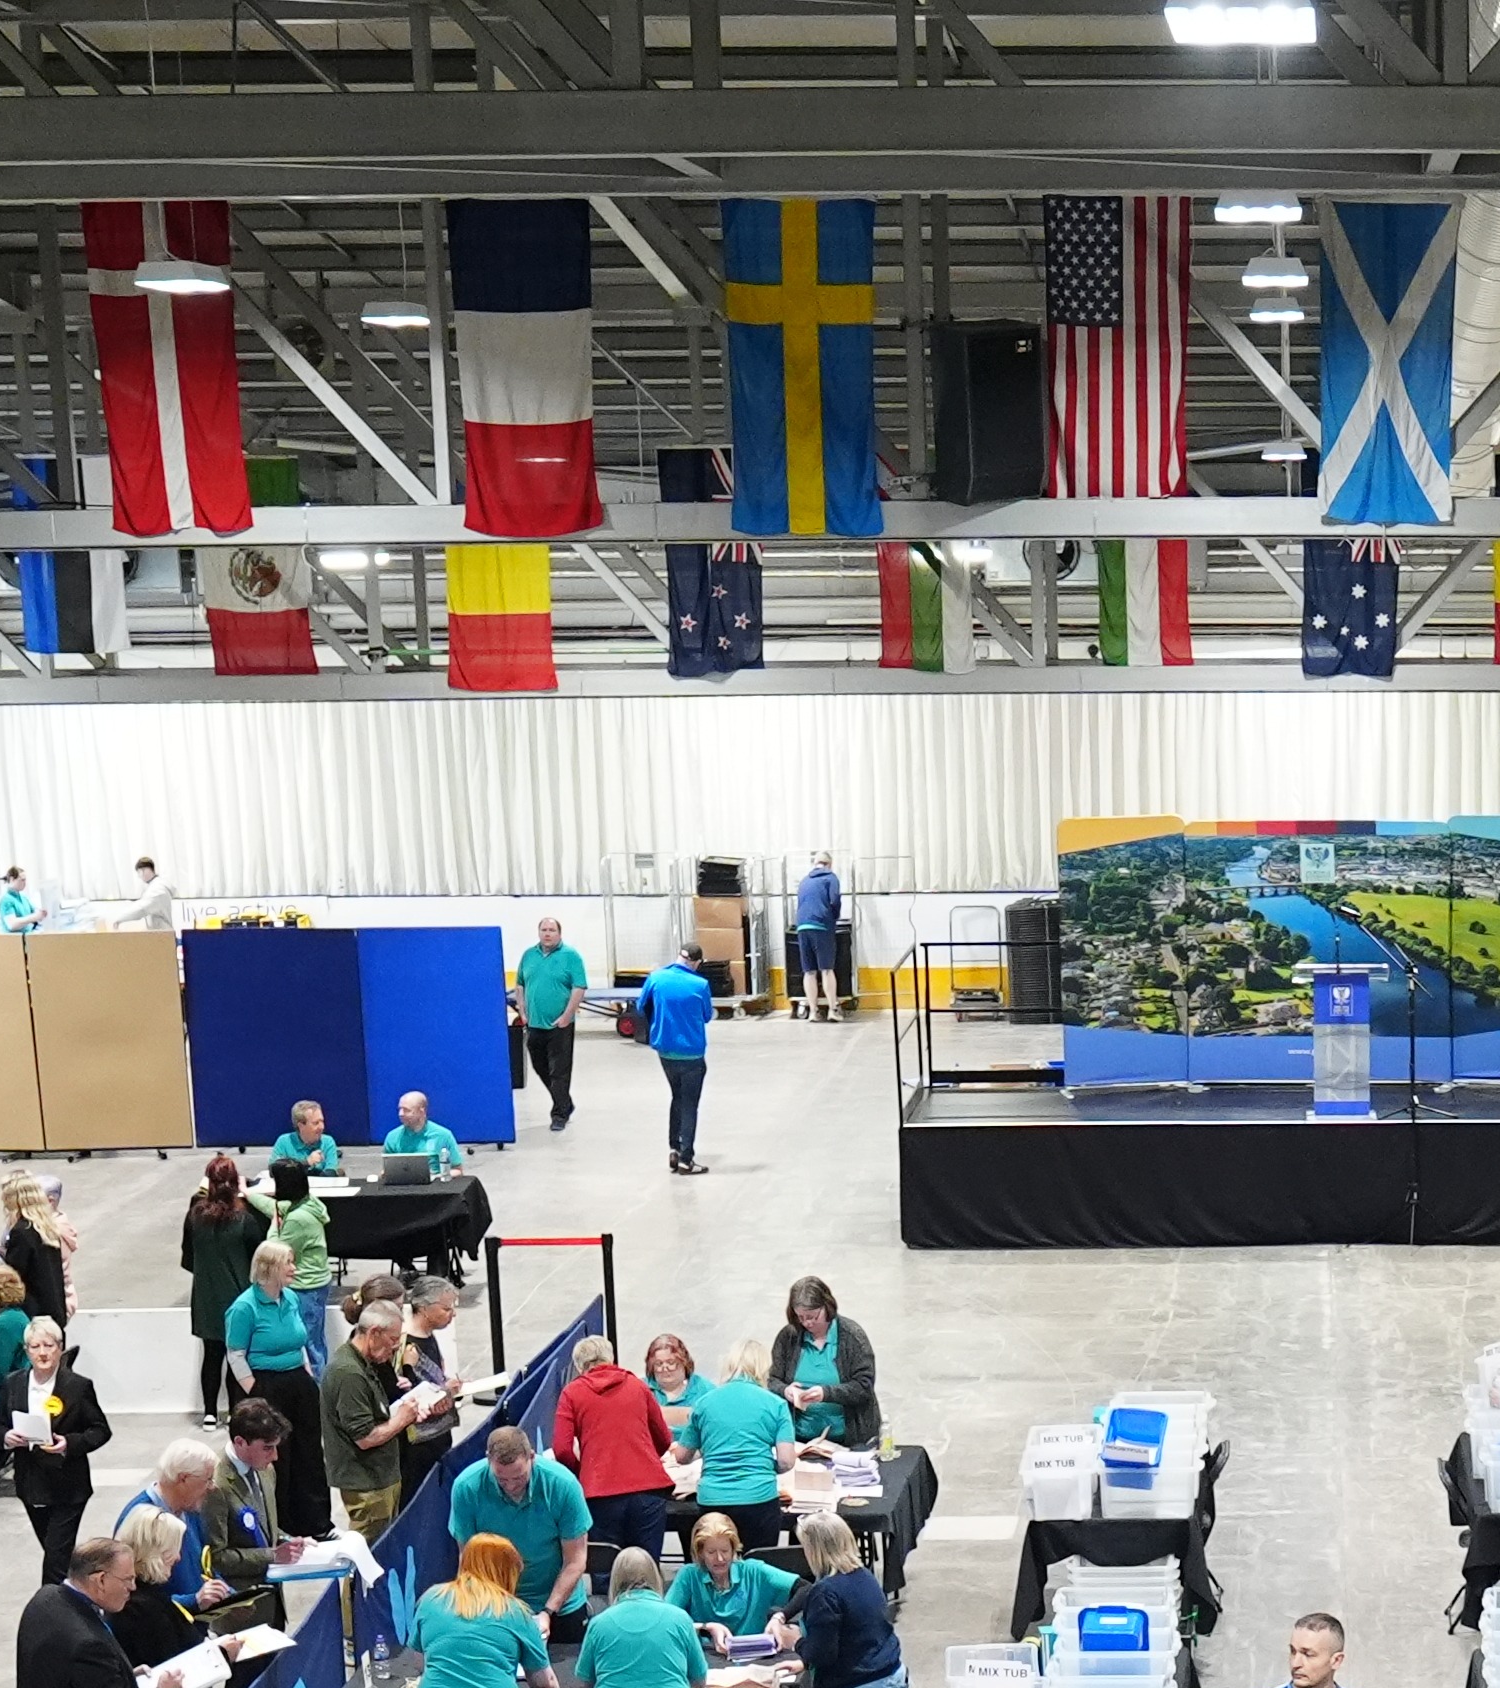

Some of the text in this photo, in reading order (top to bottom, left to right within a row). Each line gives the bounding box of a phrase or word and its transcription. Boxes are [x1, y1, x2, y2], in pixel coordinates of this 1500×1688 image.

[1043, 1435, 1084, 1444] MIX TUB
[1034, 1459, 1076, 1469] MIX TUB
[978, 1666, 1000, 1677] MIX
[1003, 1667, 1028, 1678] TUB
